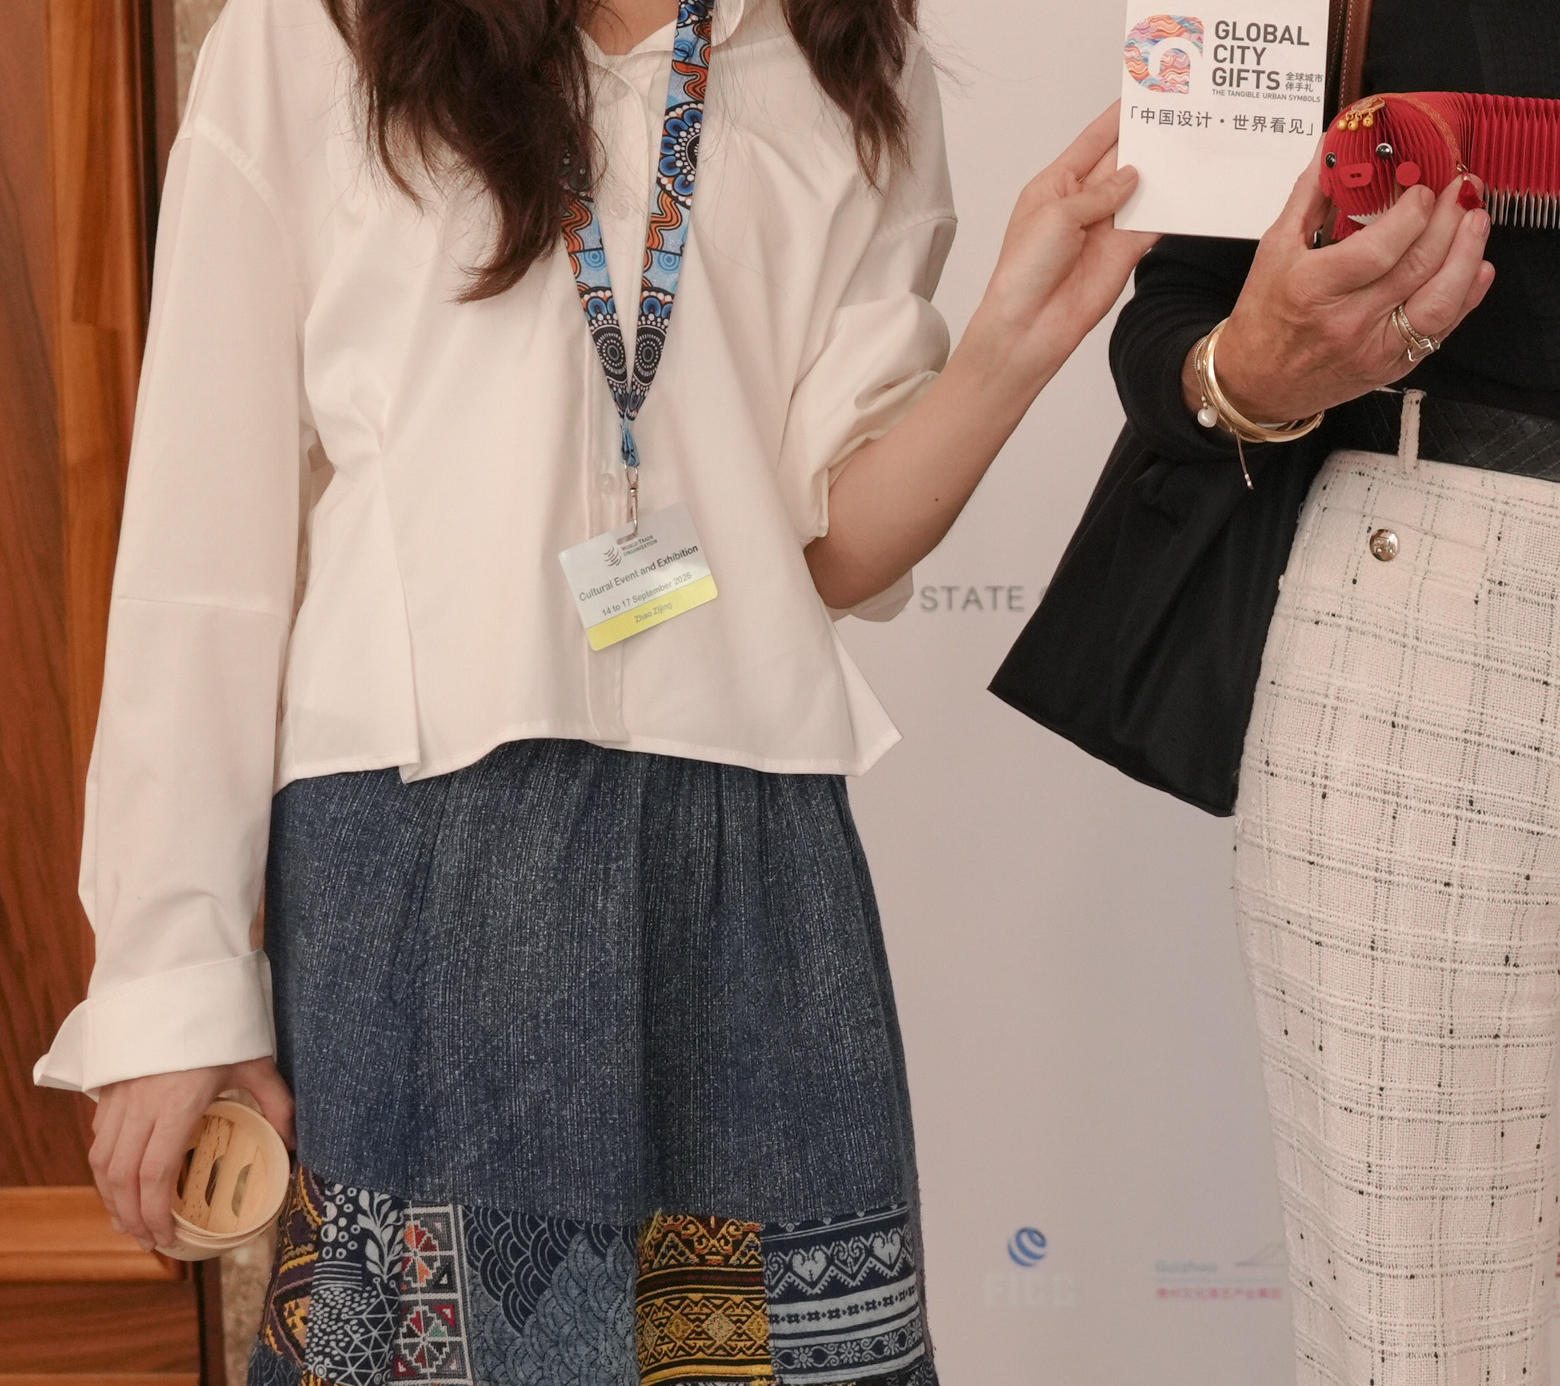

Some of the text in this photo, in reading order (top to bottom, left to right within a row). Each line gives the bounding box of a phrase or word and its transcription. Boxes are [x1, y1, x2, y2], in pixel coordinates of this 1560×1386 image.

[1215, 20, 1310, 46] GLOBAL
[1213, 44, 1267, 66] CITY
[1212, 67, 1280, 90] GIFTS
[1285, 72, 1324, 83] 全球城市
[1285, 82, 1314, 93] 伴手礼
[1212, 88, 1321, 103] THE TANGIBLE URBAN SYMBOLS
[579, 545, 699, 603] Cultural Event and Exhibition
[602, 607, 612, 617] 14
[612, 604, 621, 613] to
[622, 598, 631, 608] 17
[632, 581, 672, 604] September
[920, 585, 1025, 613] STATE
[634, 611, 653, 623] Zhao
